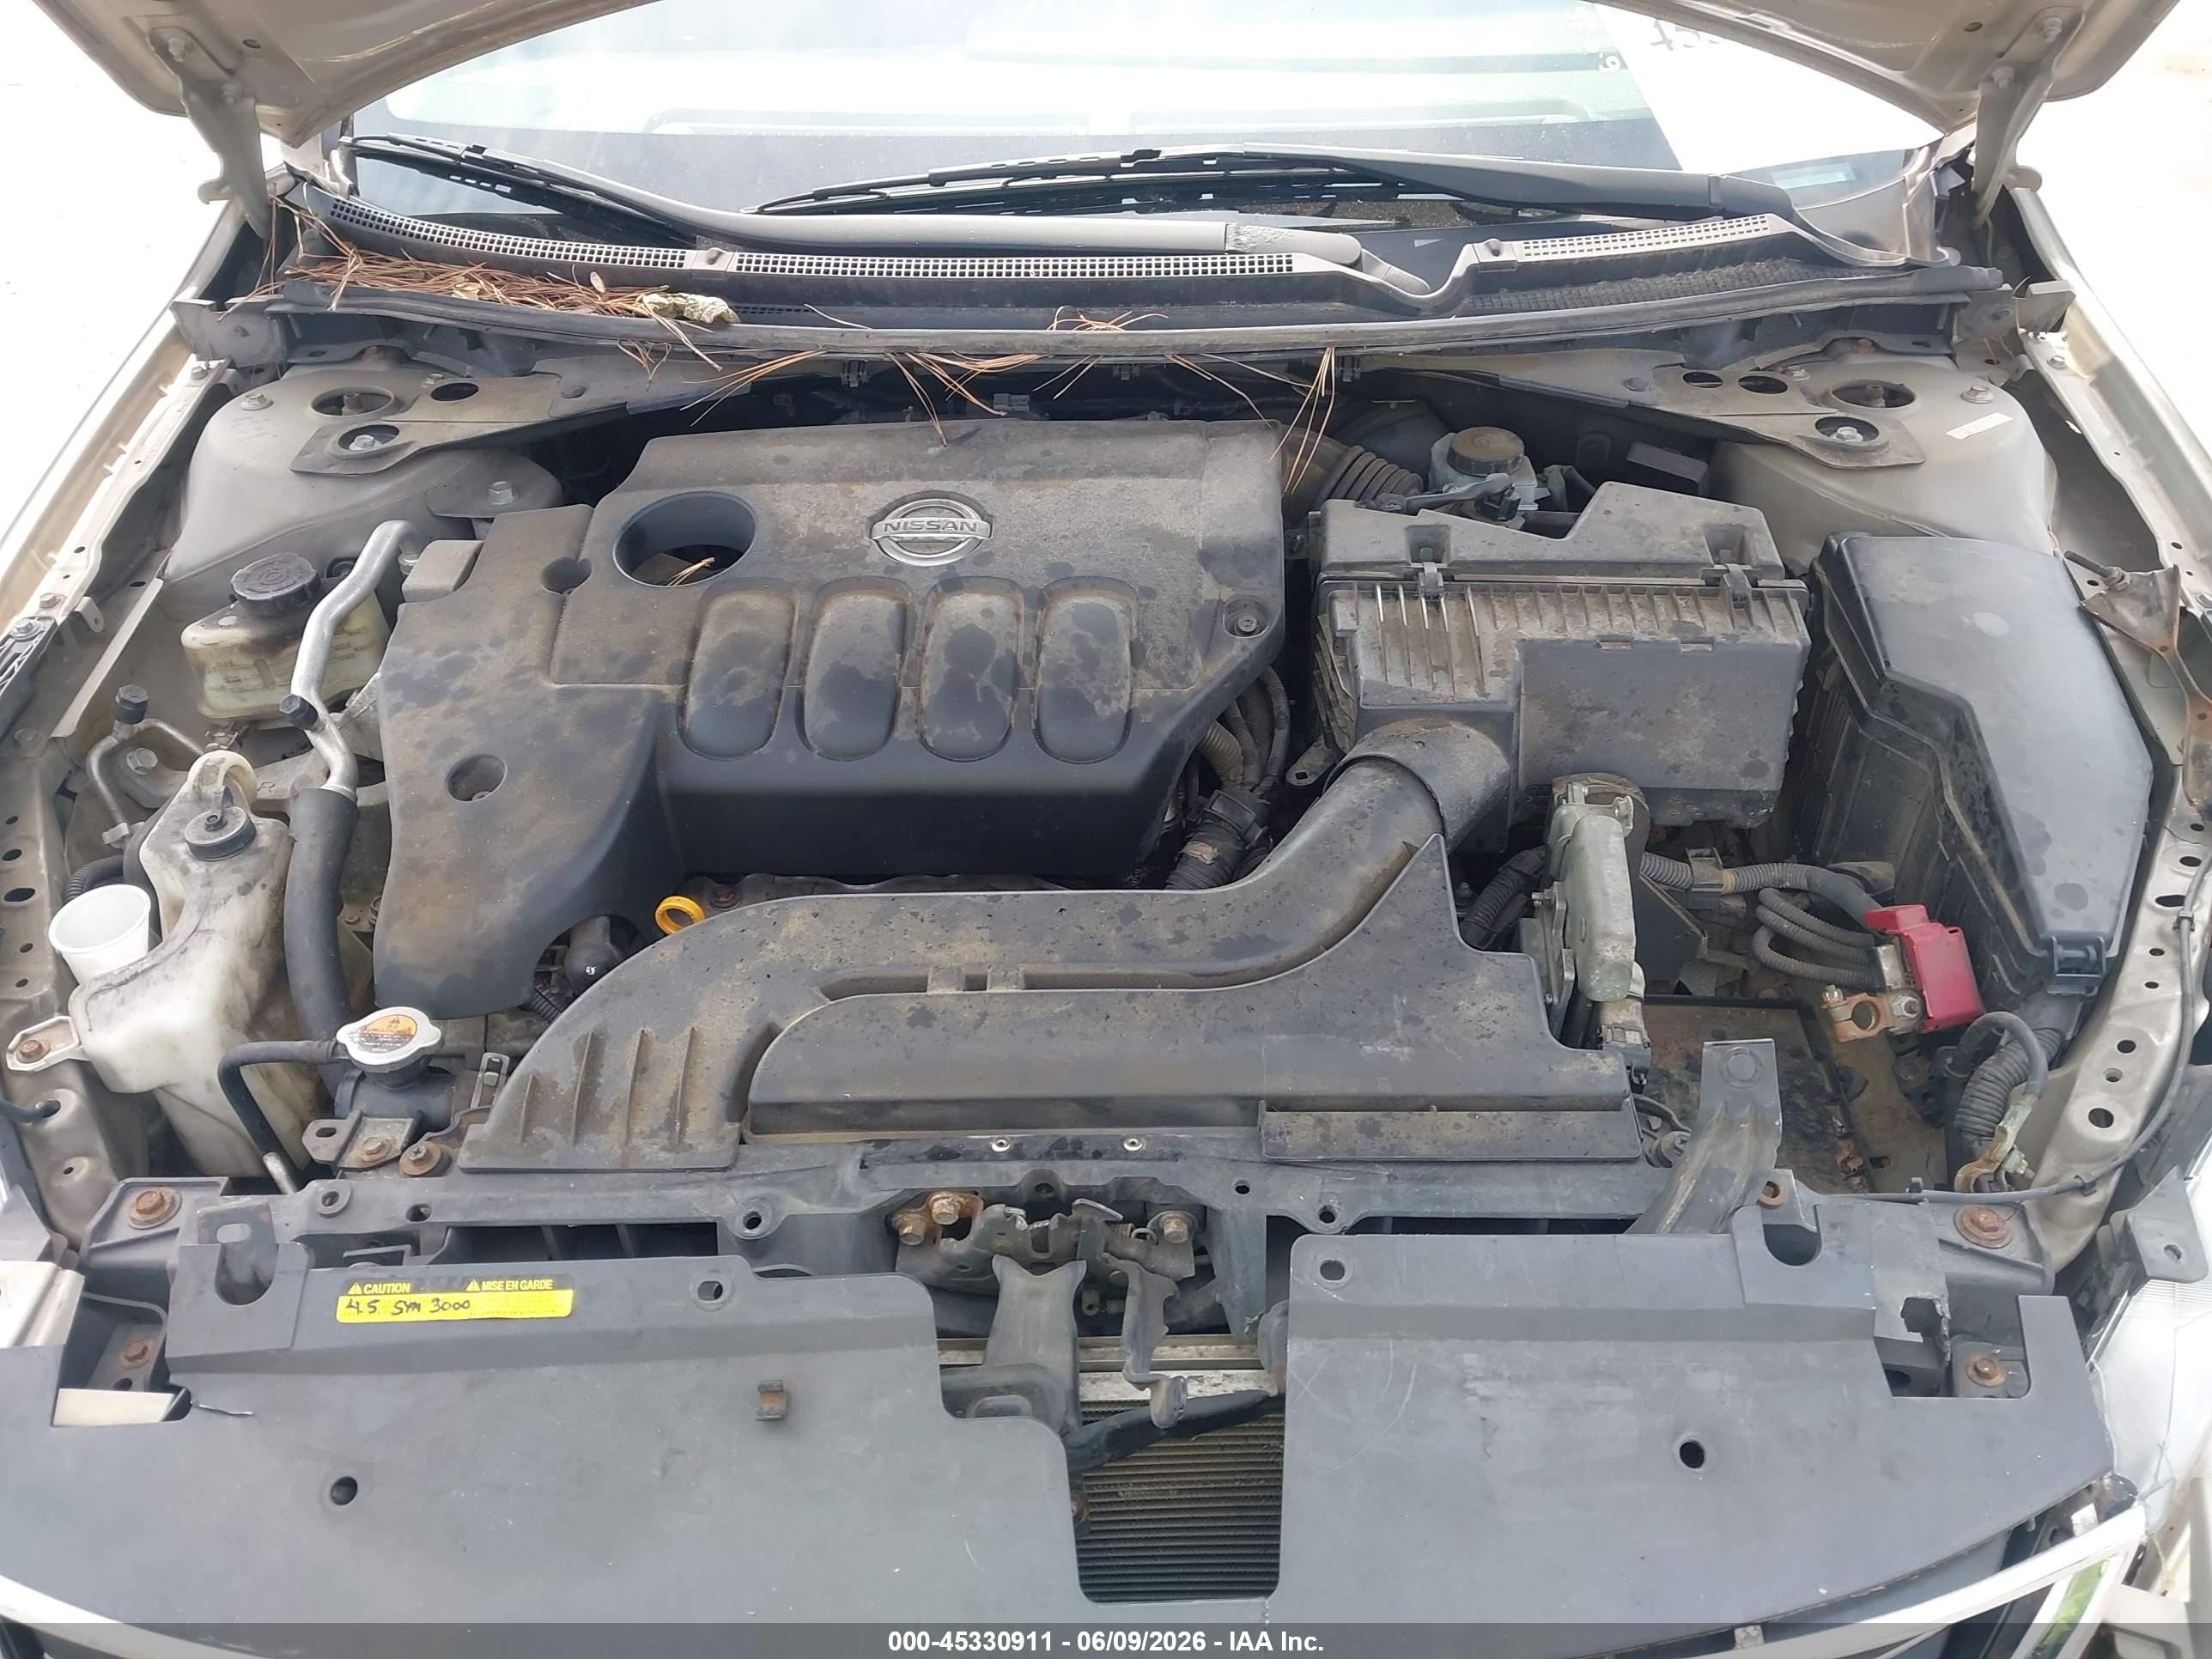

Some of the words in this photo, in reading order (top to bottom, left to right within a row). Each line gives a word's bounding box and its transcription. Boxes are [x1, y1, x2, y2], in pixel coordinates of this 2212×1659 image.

[883, 520, 978, 532] NISSAN
[363, 1282, 411, 1295] CAUTION
[481, 1279, 504, 1291] MISE
[505, 1279, 519, 1291] EN
[520, 1278, 554, 1291] GARDE
[428, 1297, 471, 1314] 3000
